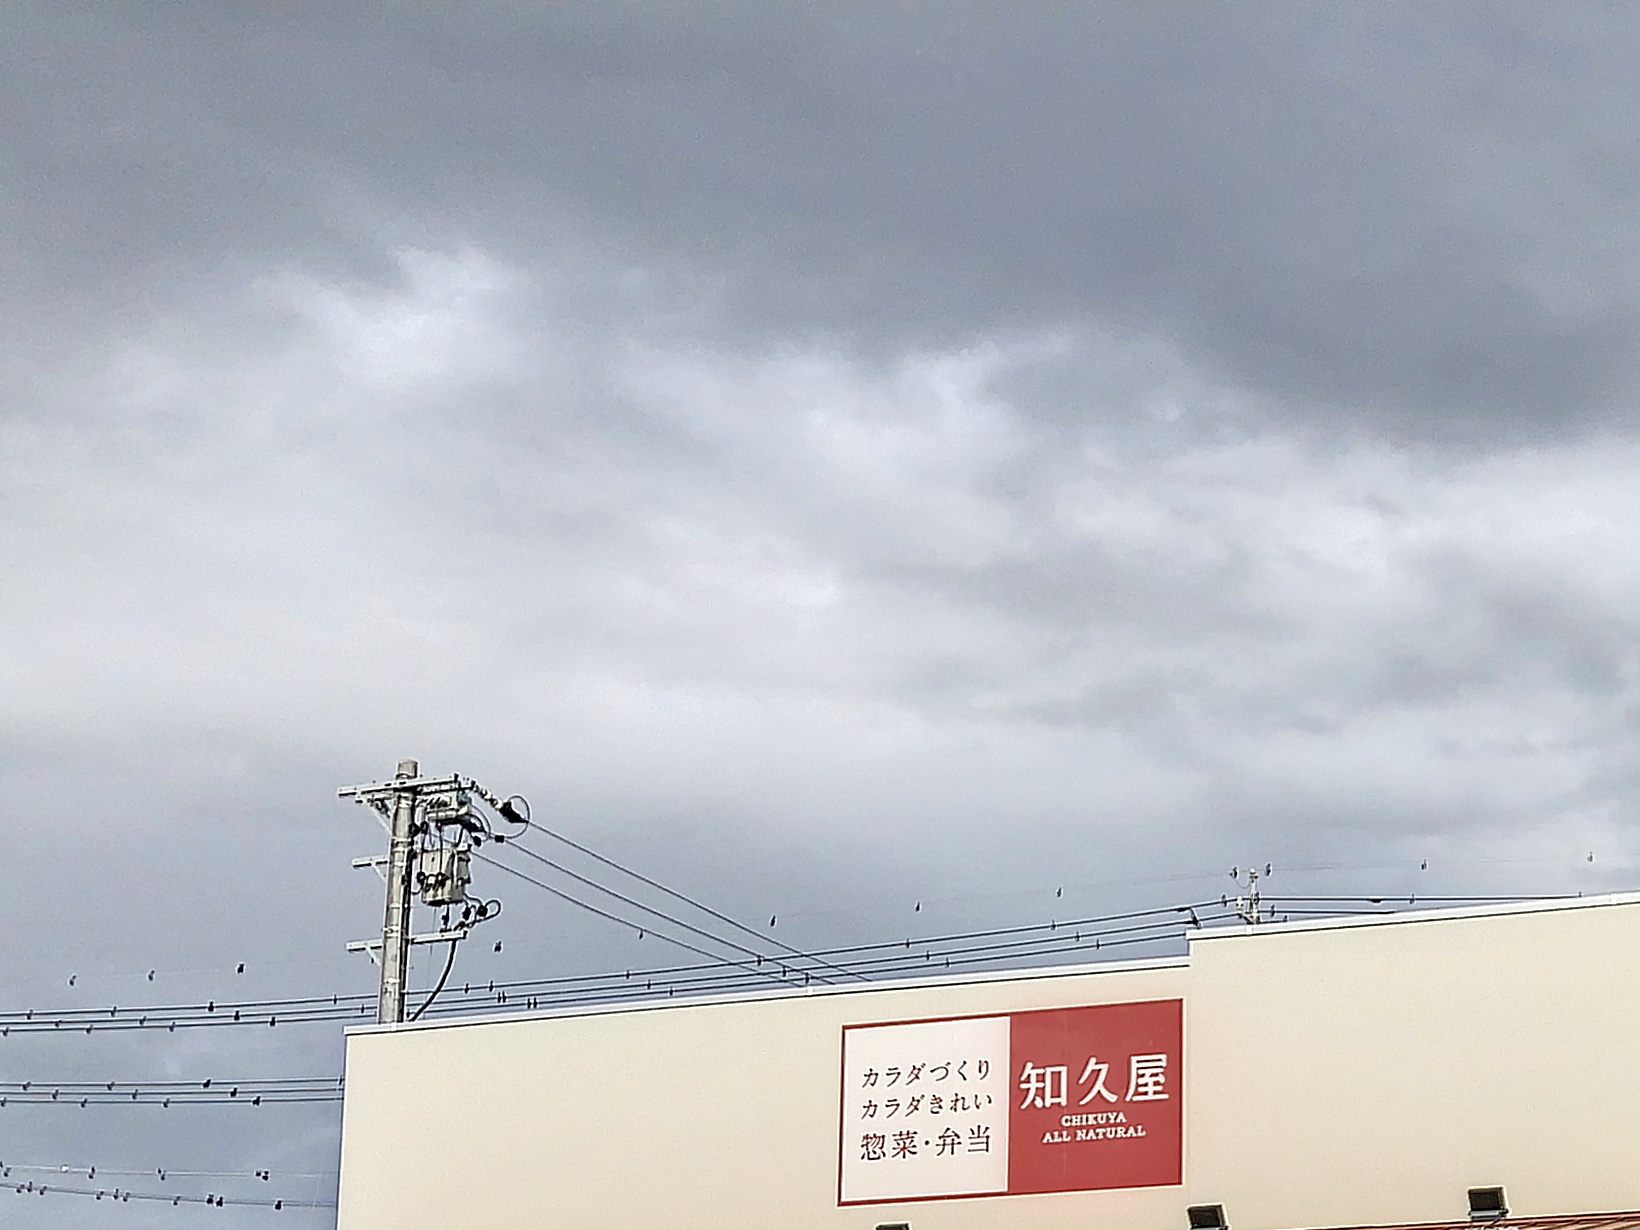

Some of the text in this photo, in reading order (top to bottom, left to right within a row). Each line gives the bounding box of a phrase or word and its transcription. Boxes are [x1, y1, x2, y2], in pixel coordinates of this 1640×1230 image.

[861, 1060, 989, 1088] カラダづくり
[1019, 1053, 1170, 1110] 知久屋
[861, 1092, 992, 1119] カラダきれい
[1061, 1111, 1127, 1127] CHIKUYA
[860, 1124, 990, 1160] 惣菜・弁当
[1042, 1125, 1146, 1144] ALL NATURAL
